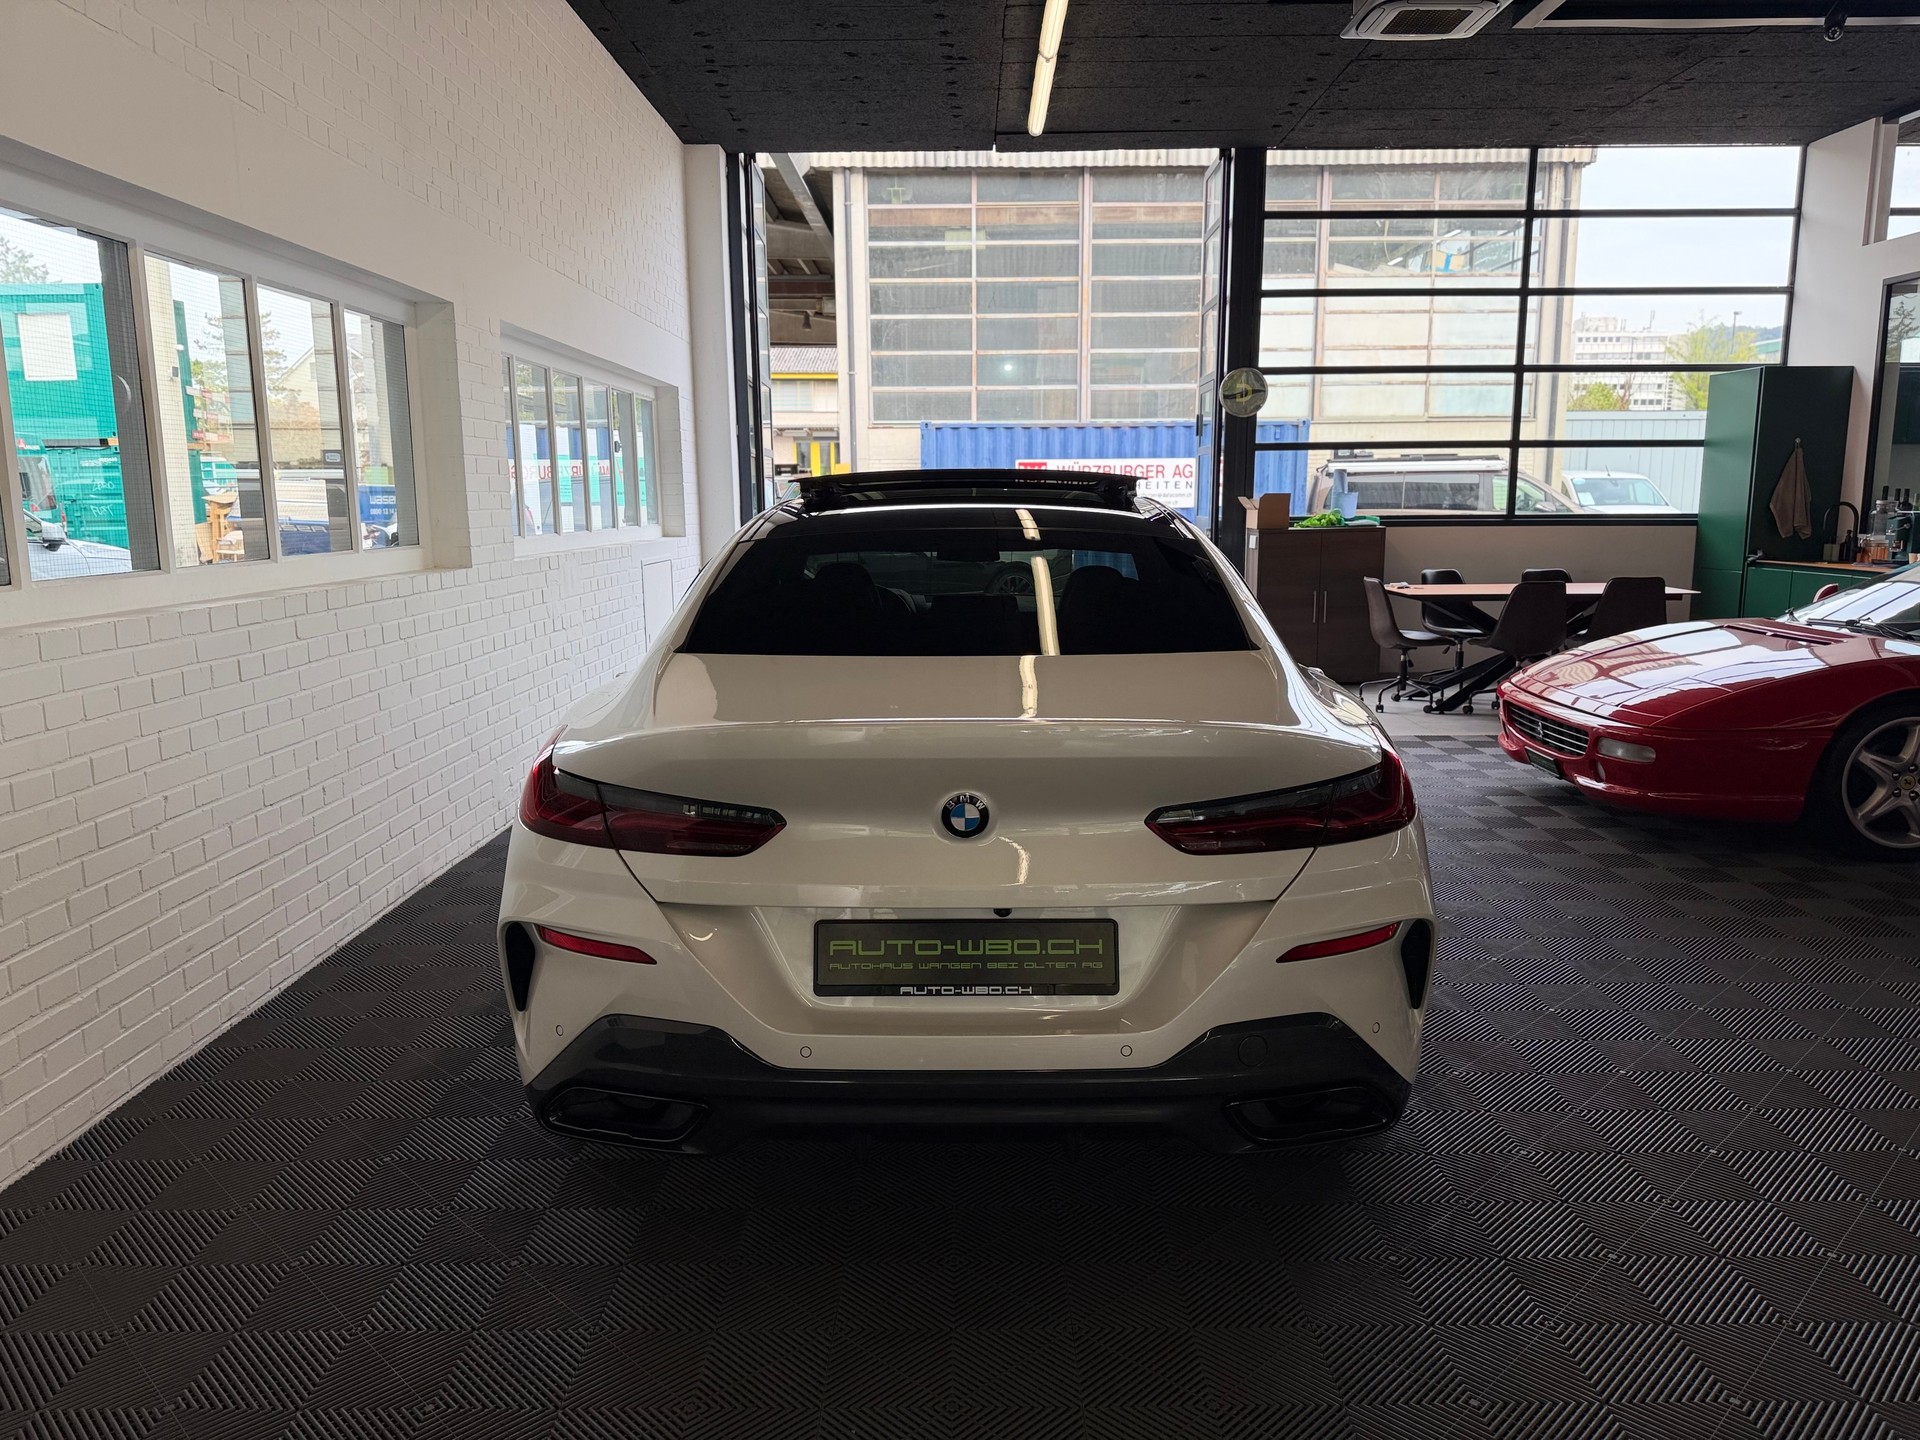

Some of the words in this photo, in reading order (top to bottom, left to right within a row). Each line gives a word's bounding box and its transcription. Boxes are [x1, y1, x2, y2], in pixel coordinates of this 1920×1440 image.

[1172, 464, 1193, 478] AG
[946, 793, 986, 810] BMW
[829, 962, 914, 970] AUTOHAUS
[918, 962, 982, 970] WANGEN
[986, 962, 1019, 970] BEI
[1024, 962, 1077, 970] OLTEN
[1082, 961, 1104, 970] AG
